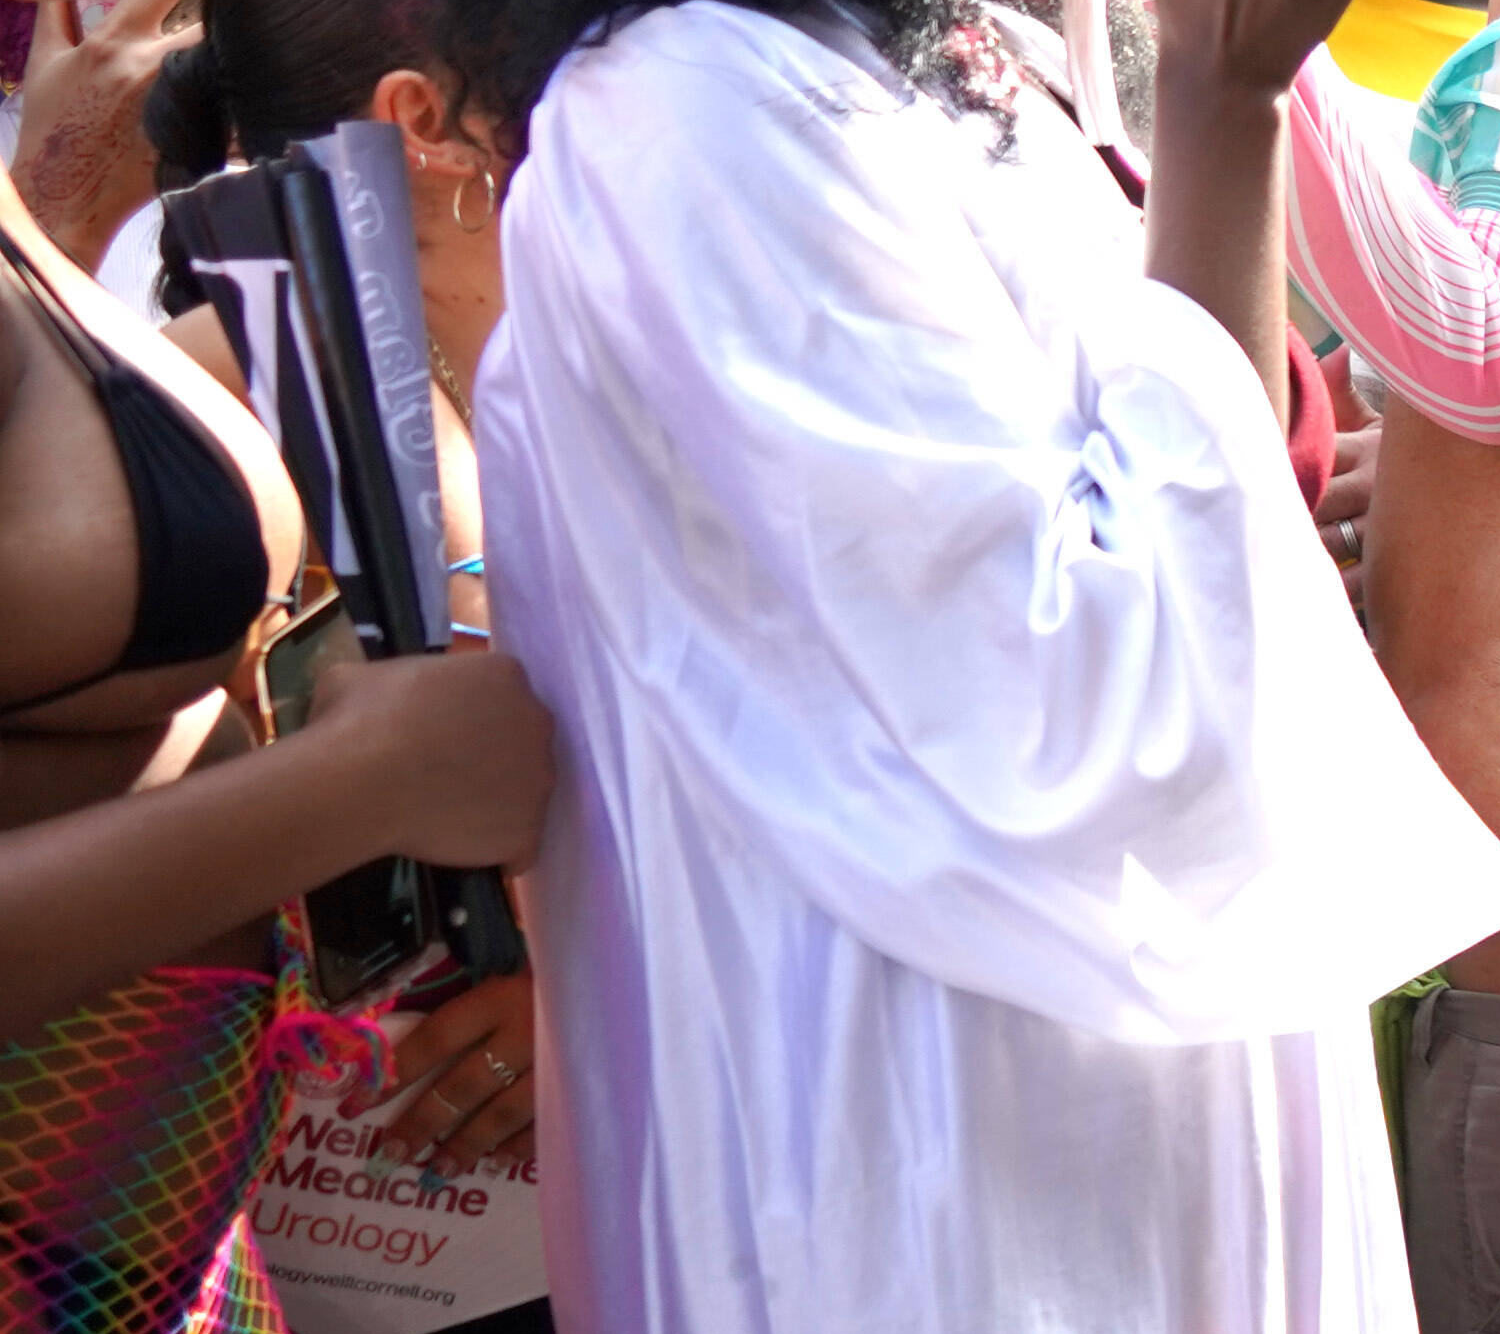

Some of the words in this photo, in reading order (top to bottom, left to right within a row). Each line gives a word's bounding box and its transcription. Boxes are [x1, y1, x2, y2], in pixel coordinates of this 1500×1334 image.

[288, 1114, 385, 1159] Weil
[251, 1198, 449, 1267] Urology
[266, 1264, 456, 1307] logy.weillcornell.org
